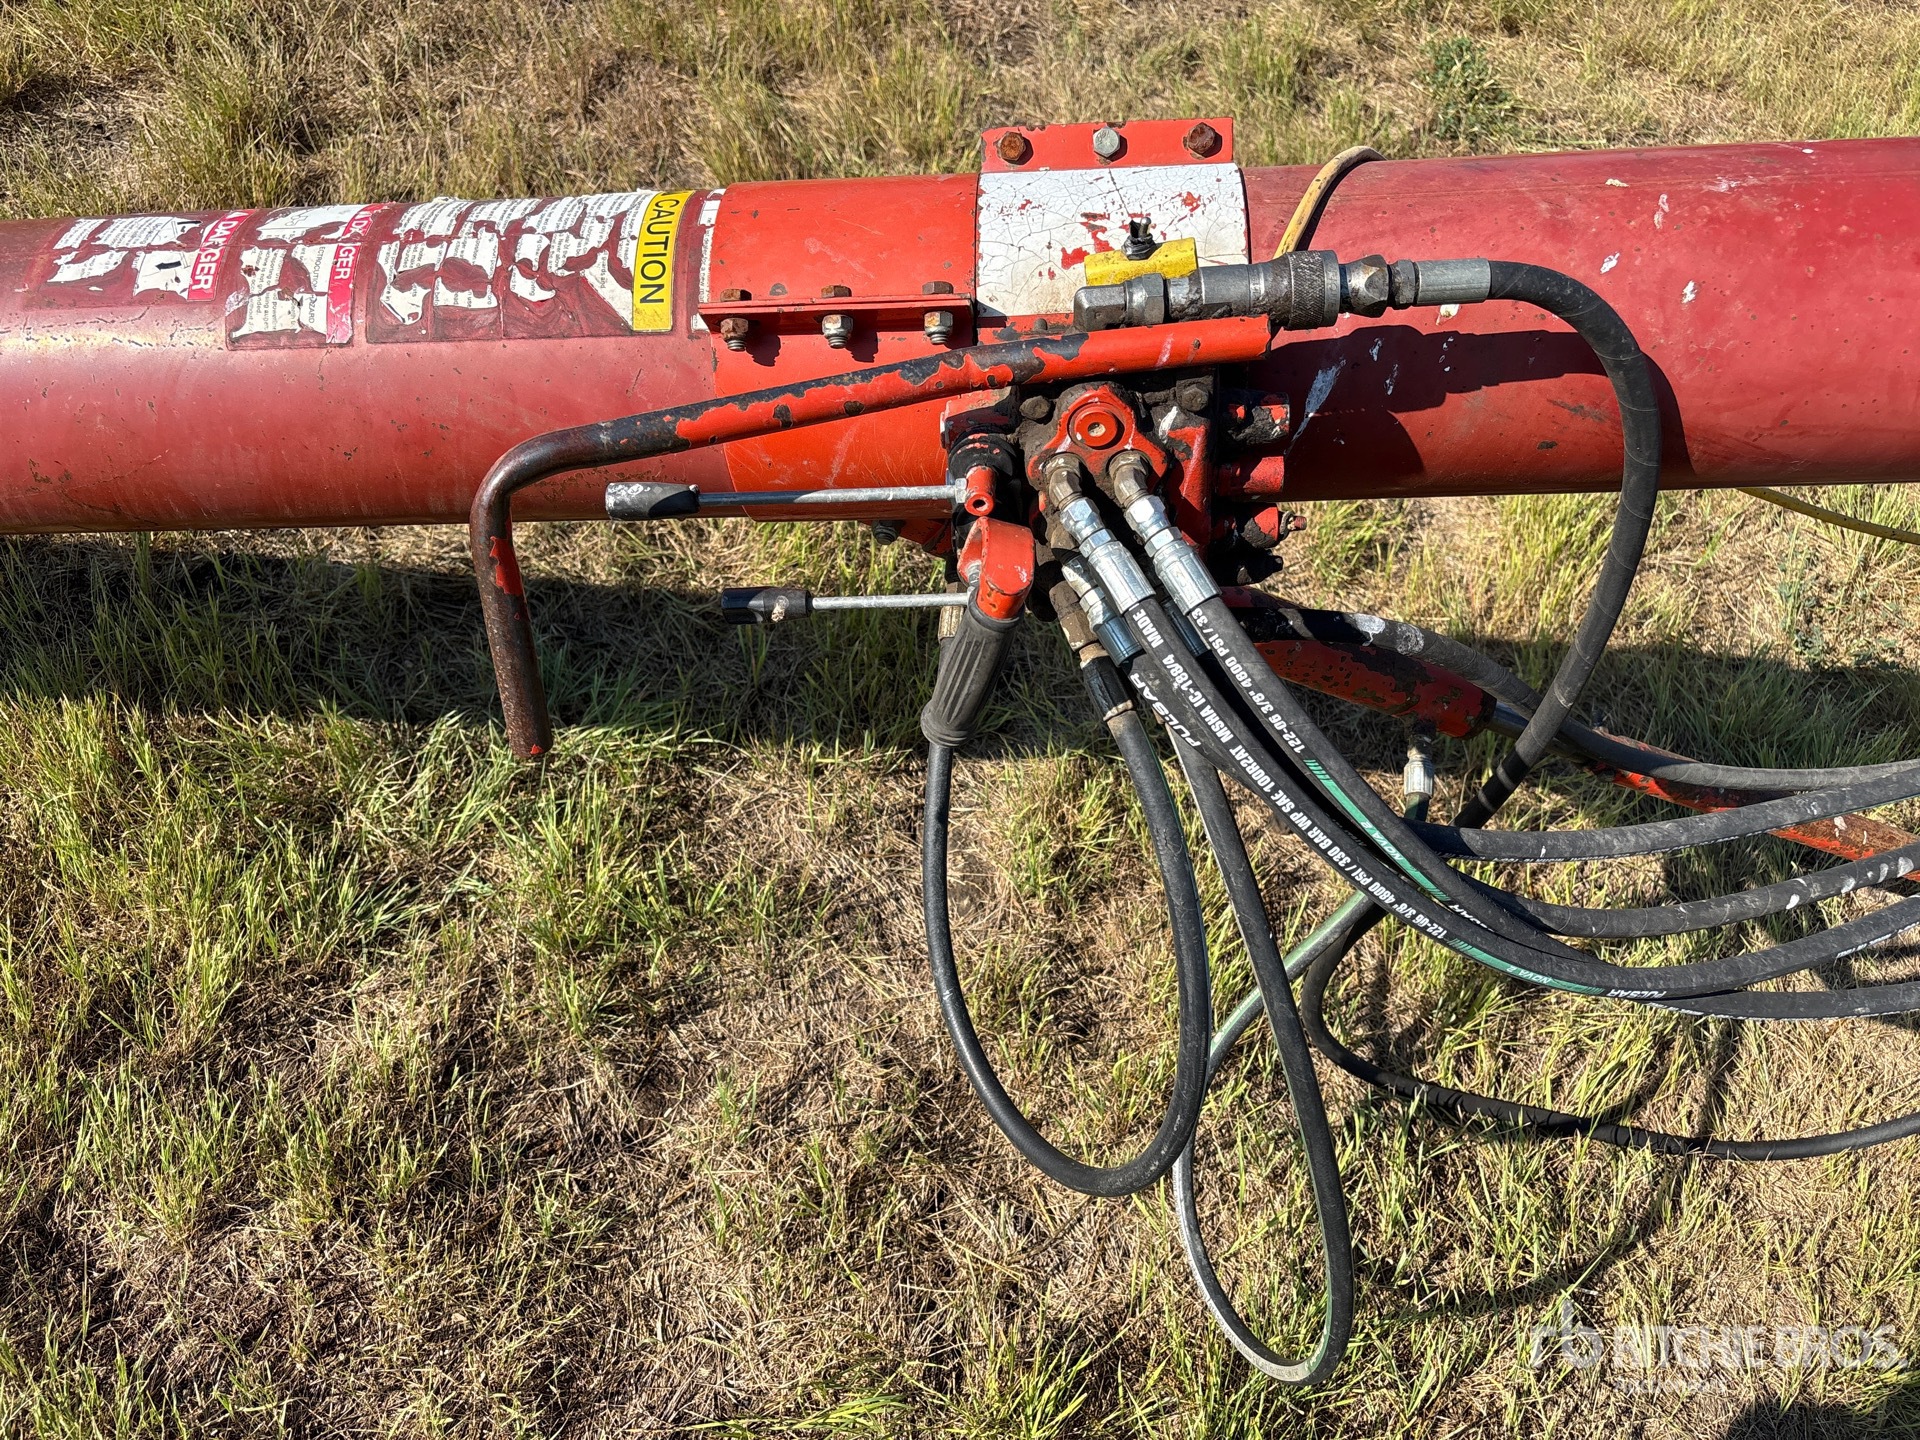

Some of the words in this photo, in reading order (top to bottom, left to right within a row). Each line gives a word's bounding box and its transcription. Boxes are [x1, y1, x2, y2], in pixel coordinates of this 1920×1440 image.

[638, 199, 680, 304] CAUTION
[312, 247, 325, 290] ECTROCUTION
[1132, 609, 1164, 648] MADE
[1192, 608, 1208, 627] 33
[1209, 632, 1229, 656] PSI
[1162, 653, 1206, 706] IC-188/4
[1224, 656, 1253, 688] 4800
[1130, 672, 1201, 746] PULSAR
[1199, 704, 1234, 743] MSHA
[1272, 714, 1306, 754] 122-06
[1229, 744, 1275, 792] 100R2AT
[1270, 790, 1295, 812] SAE
[1290, 812, 1312, 830] WP
[1308, 826, 1332, 849] BAR
[1371, 832, 1403, 860] NOVA
[1327, 846, 1351, 867] 330
[1350, 868, 1373, 886] PSI
[1368, 881, 1396, 904] 4800
[1412, 914, 1448, 939] 122-06
[1519, 968, 1551, 984] NOVA
[1606, 989, 1666, 998] PULSAR
